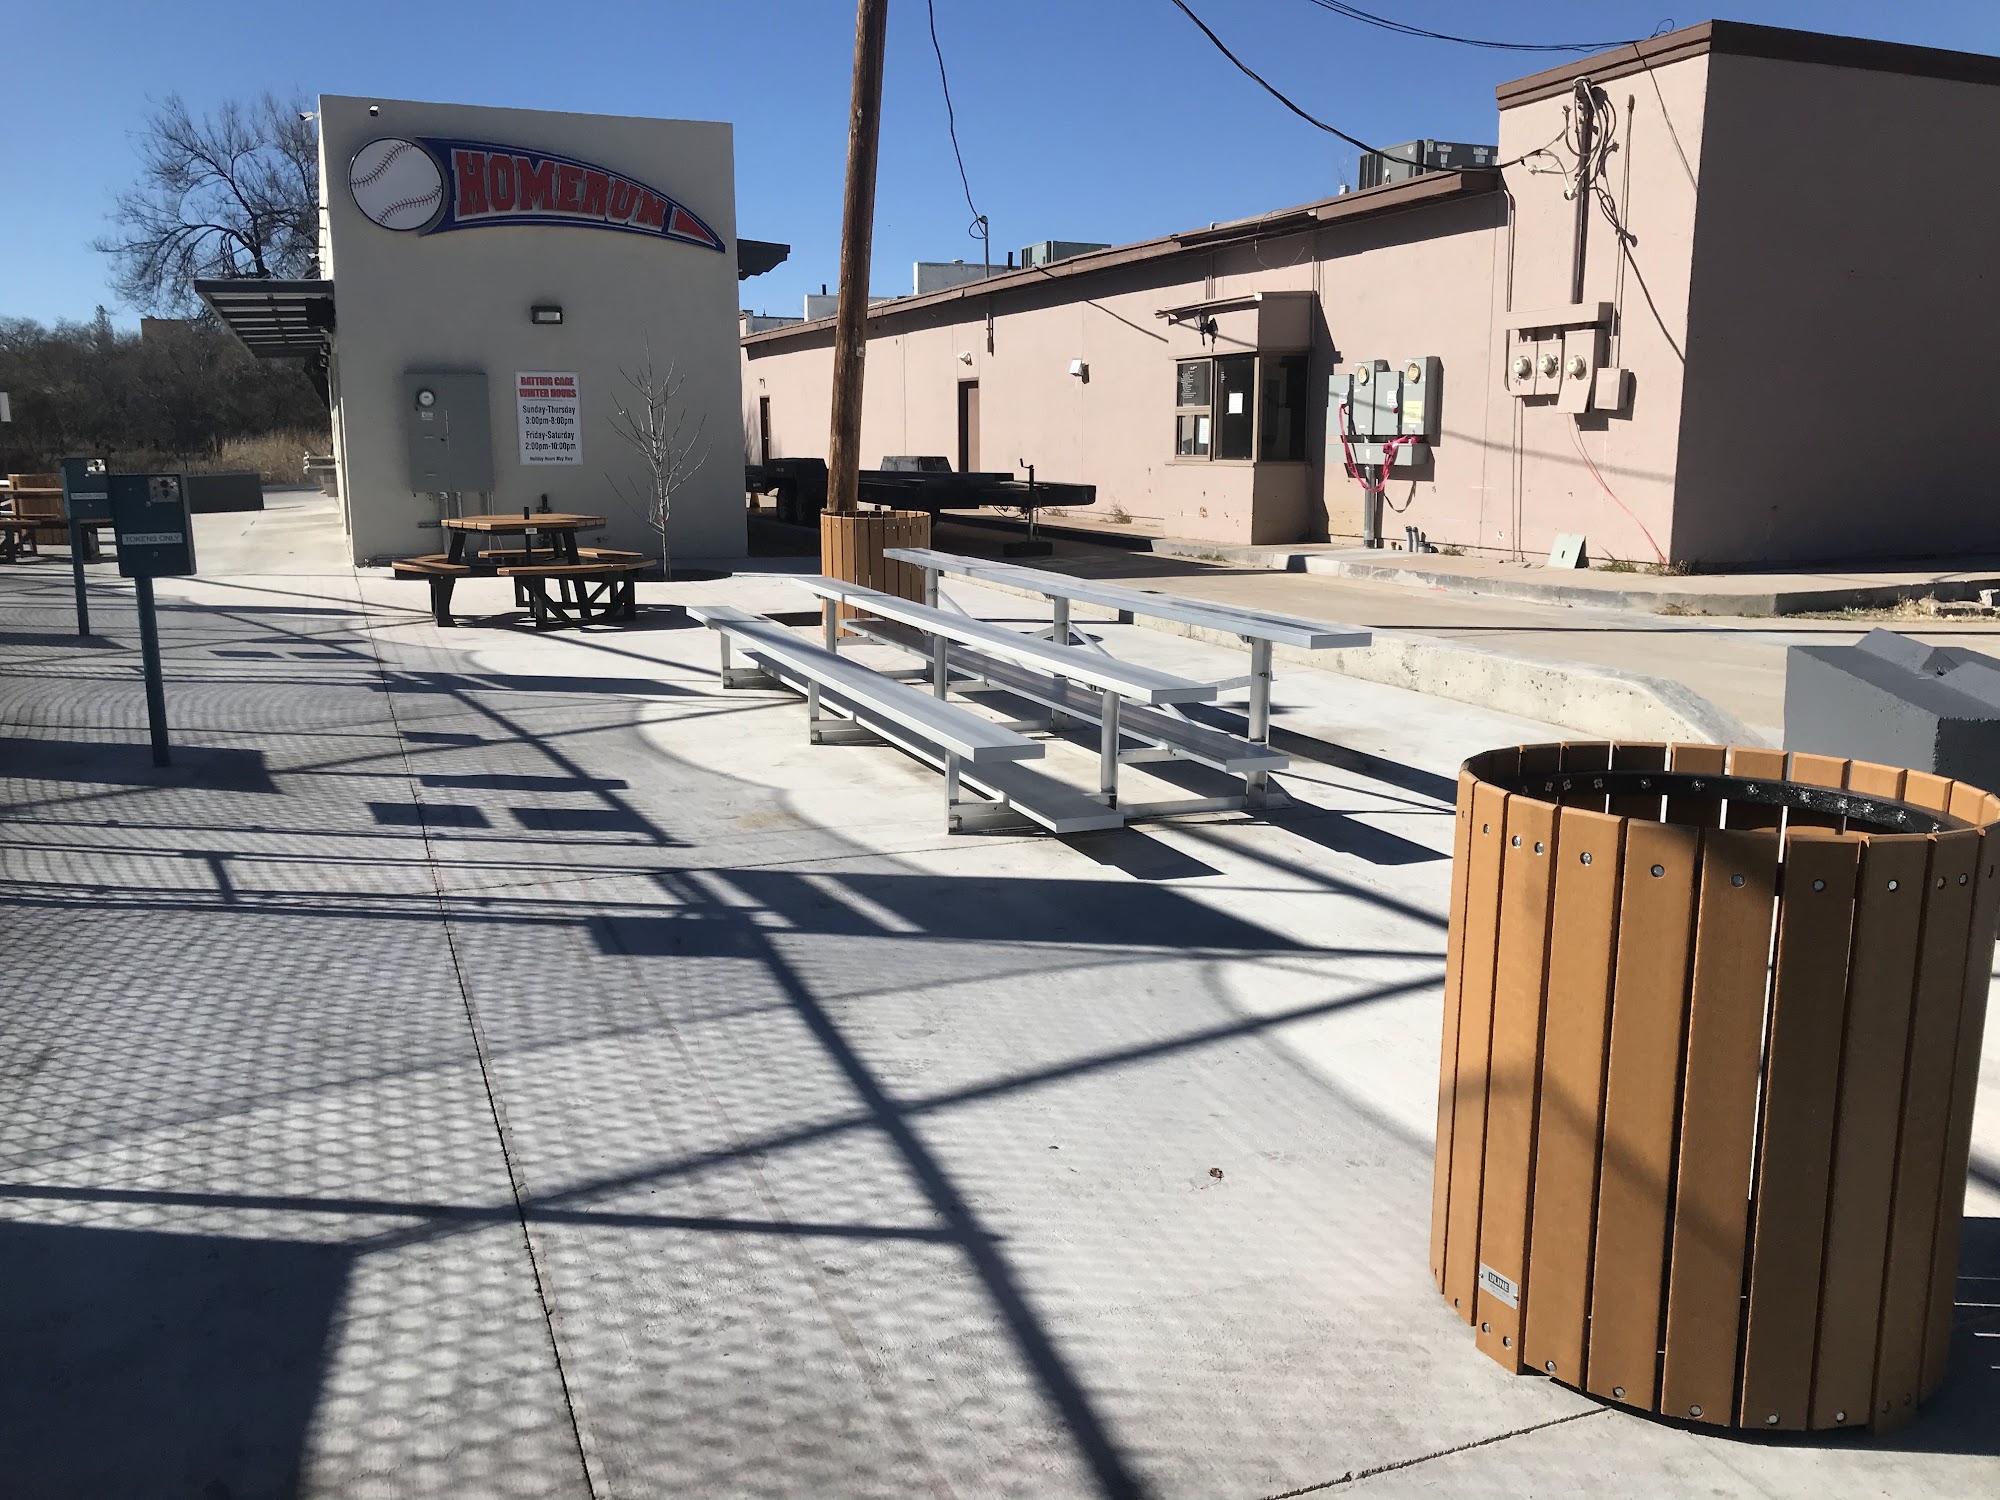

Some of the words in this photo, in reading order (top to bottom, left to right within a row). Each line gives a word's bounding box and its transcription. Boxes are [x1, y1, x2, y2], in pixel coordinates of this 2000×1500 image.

[452, 148, 669, 231] HOMERUN
[521, 377, 553, 386] BATTING
[554, 377, 574, 386] CAGE
[519, 389, 549, 398] WINTER
[551, 389, 577, 398] HOURS
[522, 405, 576, 415] Sunday-Thursday
[526, 431, 575, 441] Friday-Saturday
[125, 535, 158, 543] TOKENS
[158, 534, 180, 542] ONLY
[1489, 1272, 1509, 1292] ULINE
